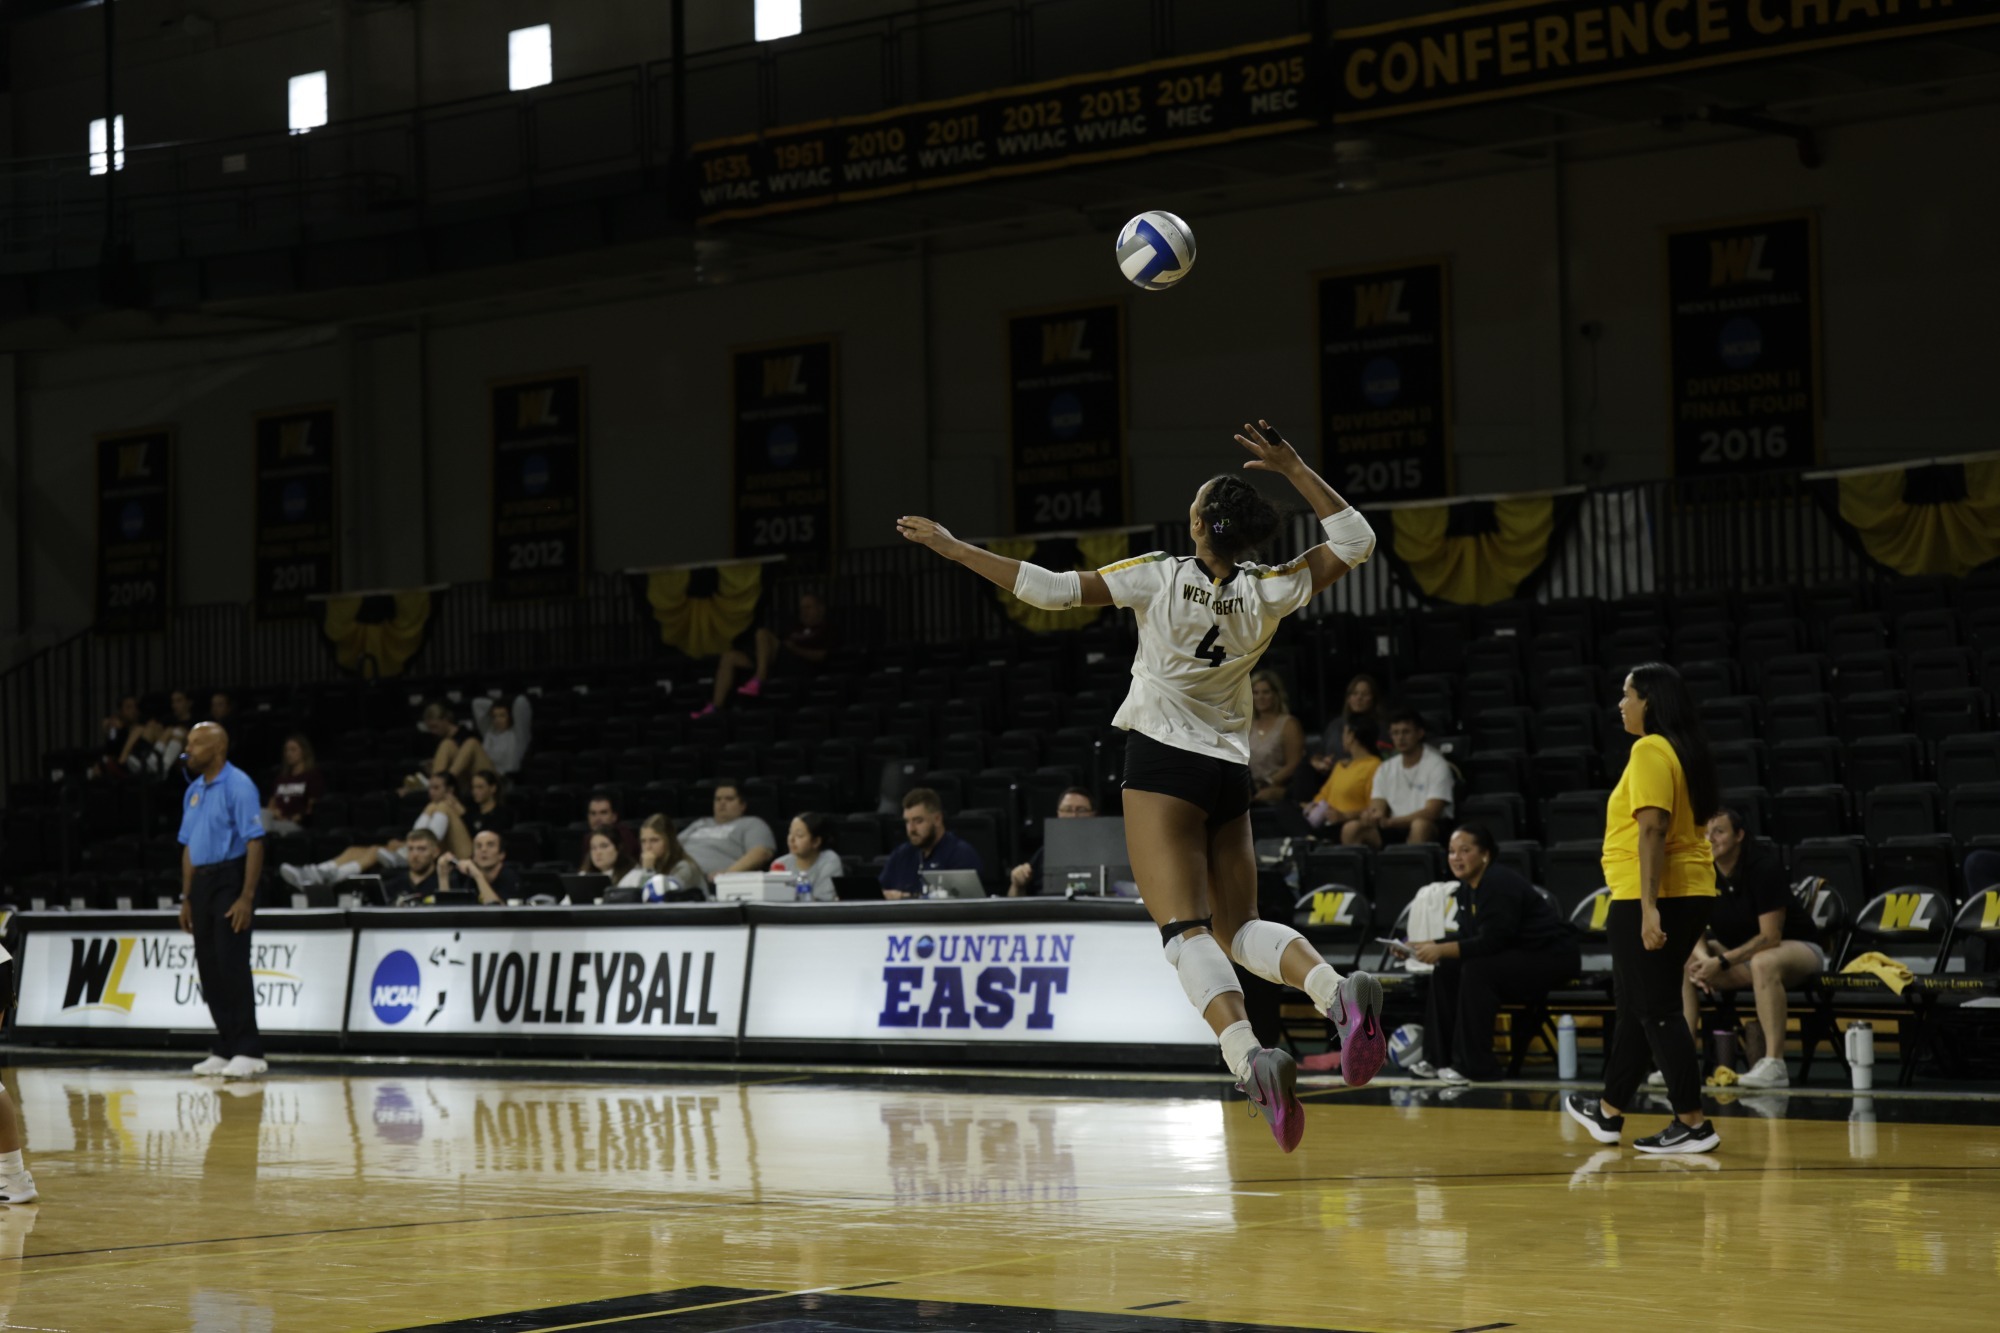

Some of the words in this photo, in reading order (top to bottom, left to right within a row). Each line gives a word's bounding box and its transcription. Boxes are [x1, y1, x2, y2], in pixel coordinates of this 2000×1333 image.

[1345, 0, 1731, 98] CONFERENCE
[774, 140, 824, 170] 1961
[847, 128, 905, 159] 2010
[925, 114, 979, 145] 2011
[1002, 100, 1063, 132] 2012
[1080, 86, 1142, 119] 2013
[1156, 71, 1223, 106] 2014
[1241, 56, 1305, 92] 2015
[768, 166, 832, 193] WVIAC
[842, 155, 907, 182] WVIAC
[918, 141, 987, 169] WVIAC
[997, 128, 1068, 156] WVIAC
[1074, 114, 1147, 143] WVIAC
[1166, 104, 1213, 128] MEC
[1250, 88, 1299, 115] MEC
[1709, 234, 1774, 287] WL
[1354, 280, 1411, 328] WL
[1686, 371, 1780, 397] DIVISION
[1680, 398, 1742, 420] FINAL
[1748, 392, 1806, 416] FOUR
[1699, 425, 1787, 462] 2016
[1345, 457, 1422, 494] 2015
[1034, 488, 1103, 523] 2014
[753, 514, 815, 546] 2013
[508, 538, 565, 571] 2012
[272, 562, 317, 592] 2011
[1183, 584, 1212, 606] WEST
[1195, 625, 1226, 667] 4
[1308, 892, 1357, 925] WL
[1879, 893, 1935, 931] WL
[885, 935, 1074, 962] MOUNTAIN
[62, 937, 137, 1012] WL
[472, 951, 718, 1026] VOLLEYBALL
[1846, 975, 1880, 987] LIBERTY
[1951, 978, 1984, 990] LIBERTY
[373, 985, 420, 1007] NCAA
[878, 966, 1069, 1029] EAST
